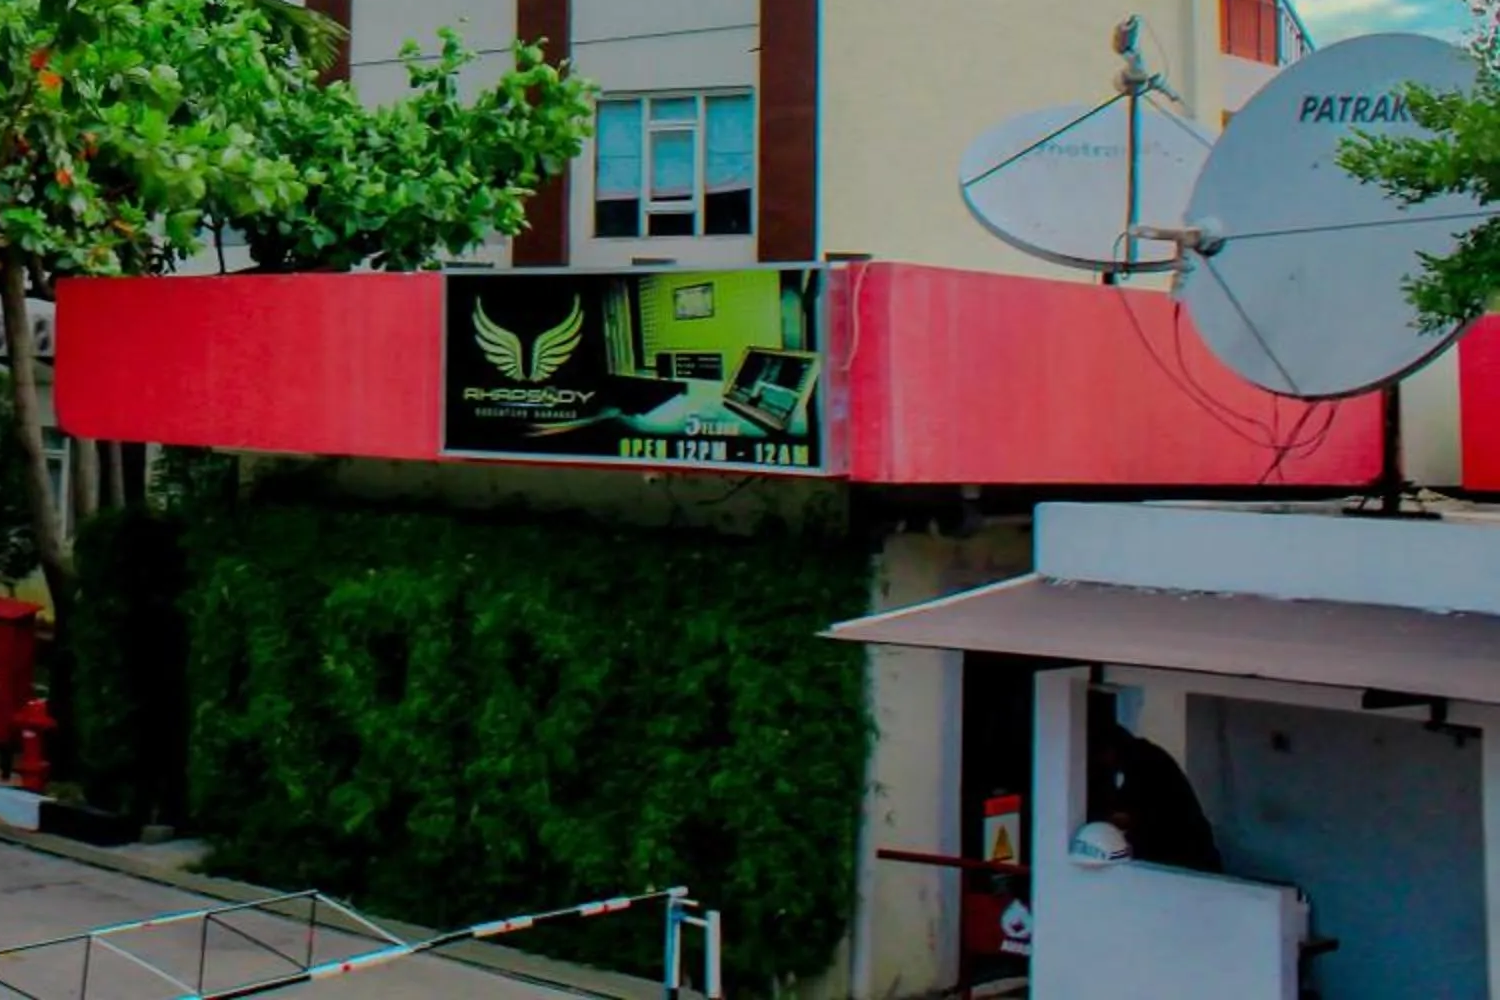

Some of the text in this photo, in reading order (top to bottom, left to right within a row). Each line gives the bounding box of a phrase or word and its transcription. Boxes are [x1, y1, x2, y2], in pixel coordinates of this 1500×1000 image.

[619, 438, 667, 459] OPEN
[676, 439, 727, 461] 12PM
[755, 443, 809, 466] 12AM
